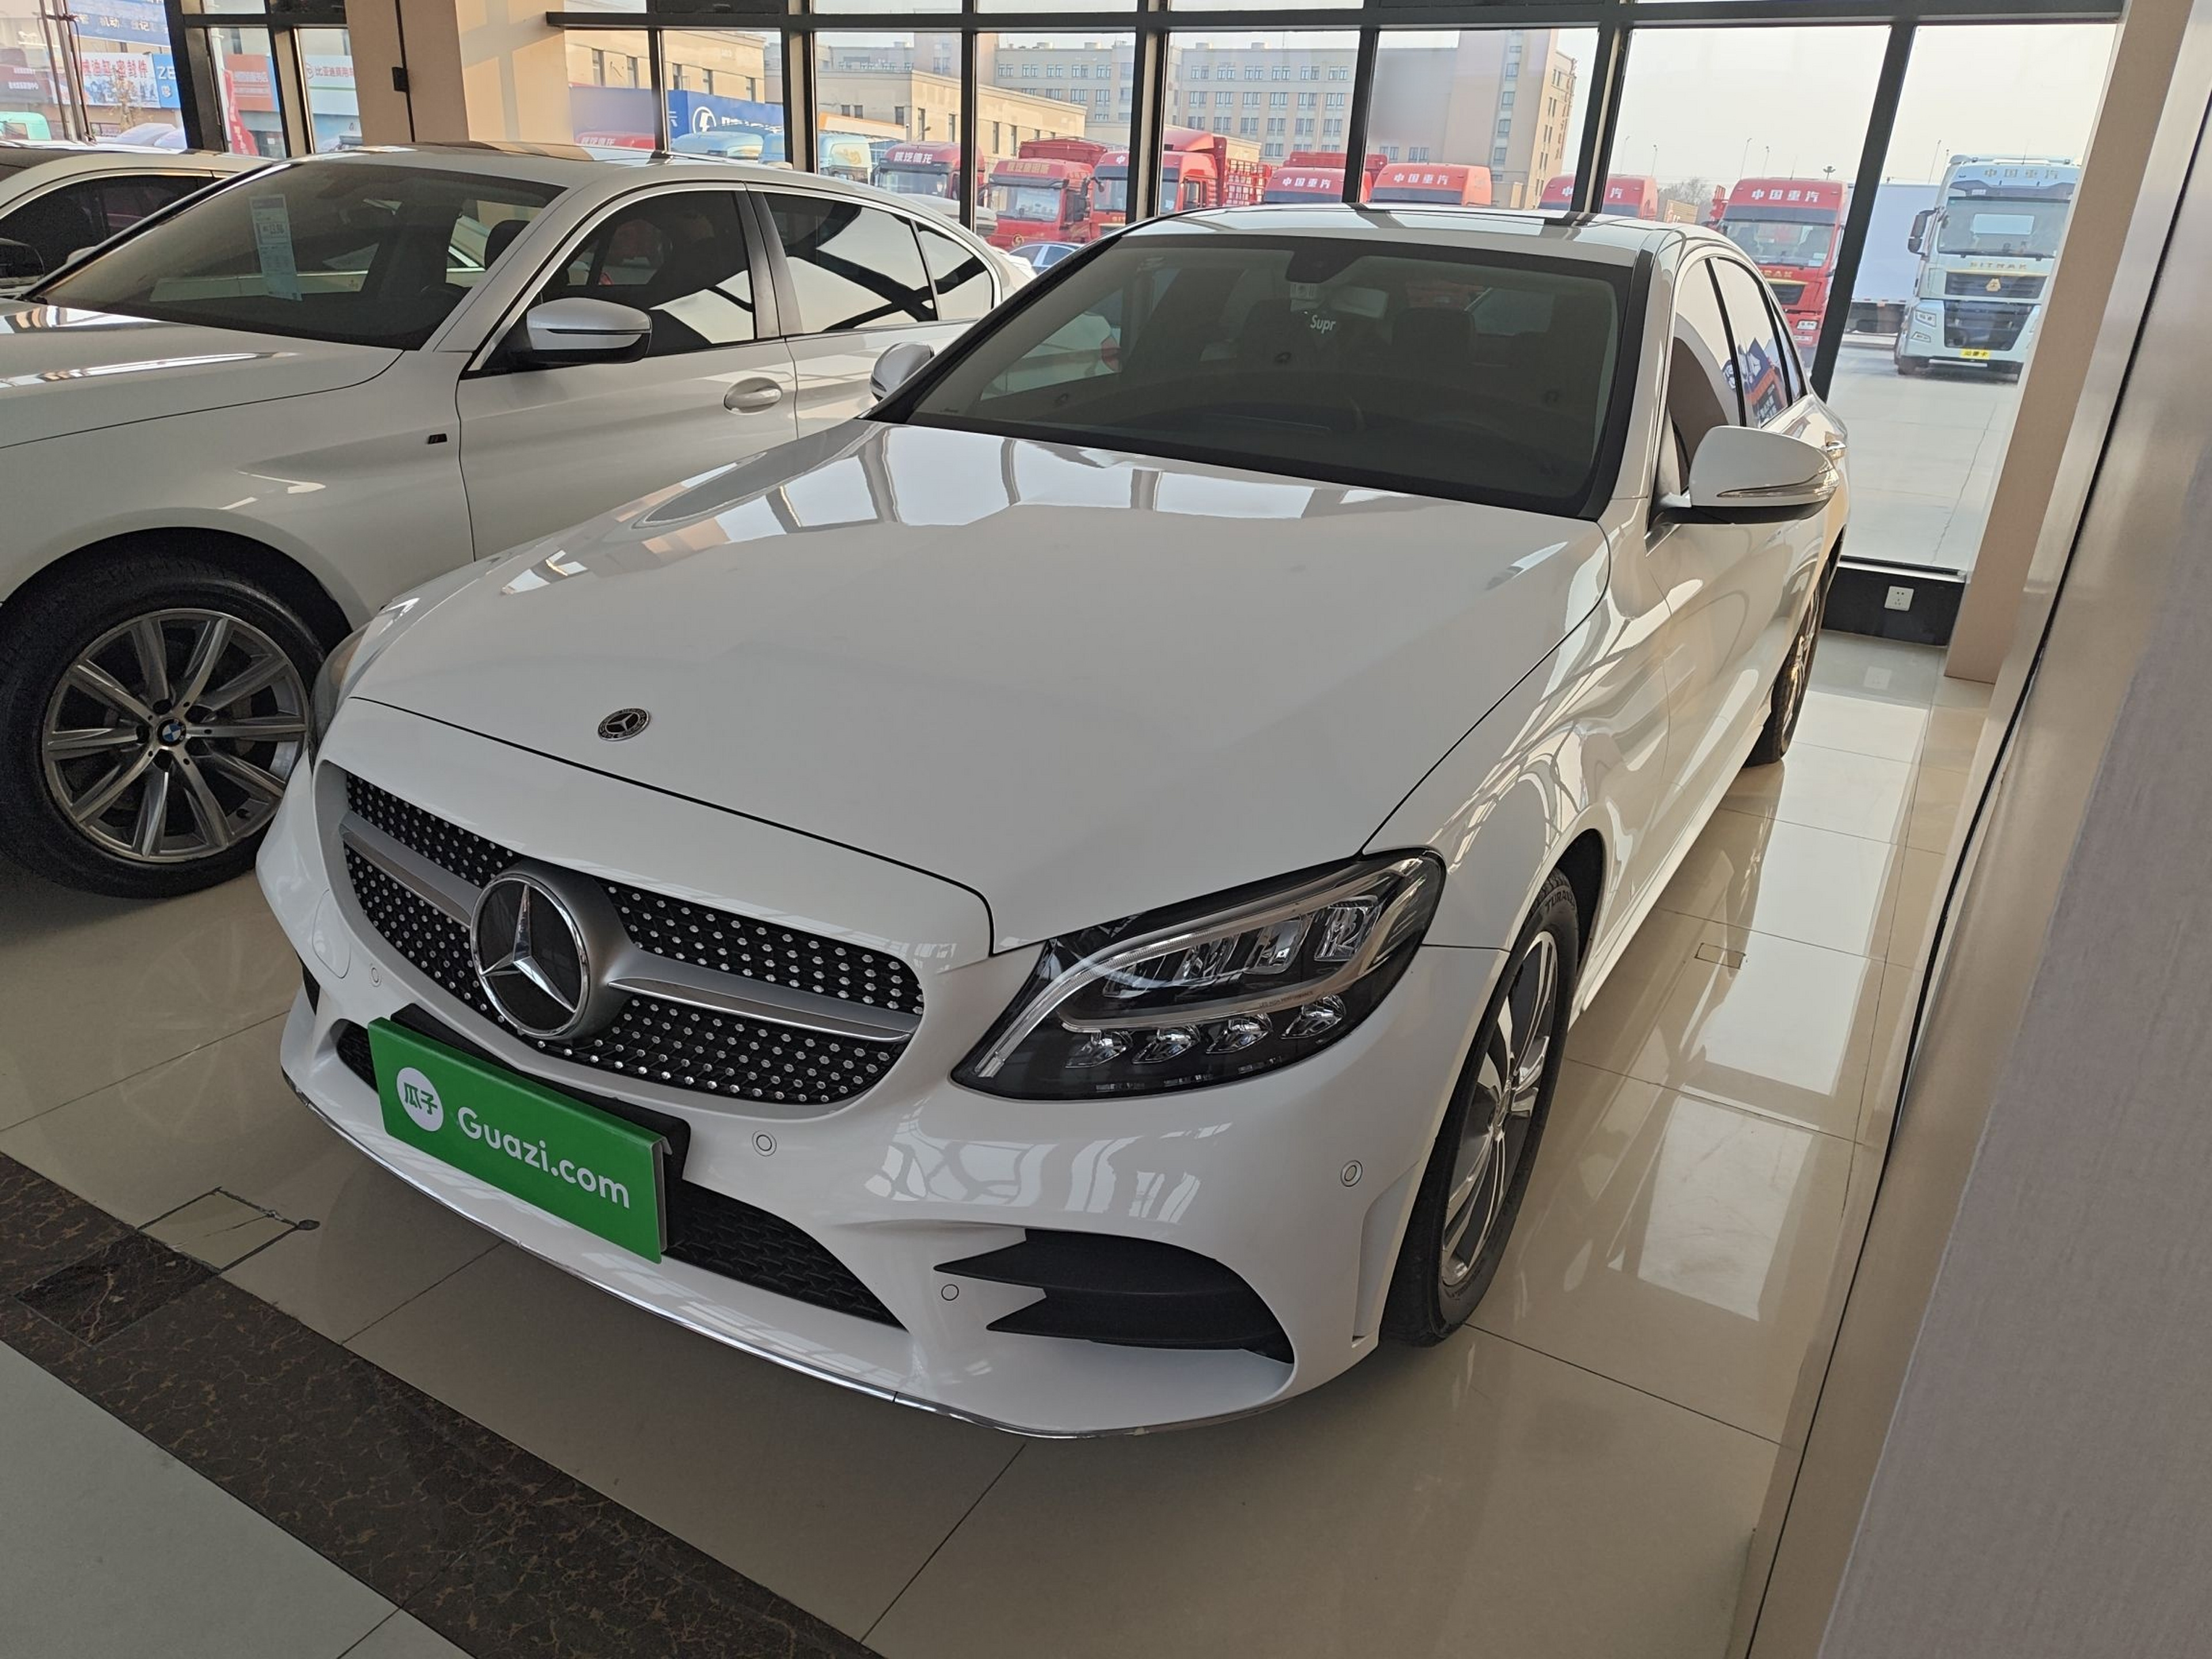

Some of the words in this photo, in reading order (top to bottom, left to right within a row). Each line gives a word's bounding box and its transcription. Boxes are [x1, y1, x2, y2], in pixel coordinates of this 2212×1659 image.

[1393, 173, 1449, 185] 中国重汽
[1983, 168, 2059, 180] 中国重汽
[1282, 176, 1332, 190] 中国重汽
[1751, 188, 1820, 203] 中国重汽
[1310, 315, 1336, 334] Supr
[403, 1082, 438, 1116] 瓜子
[457, 1107, 630, 1209] Guazi.com
